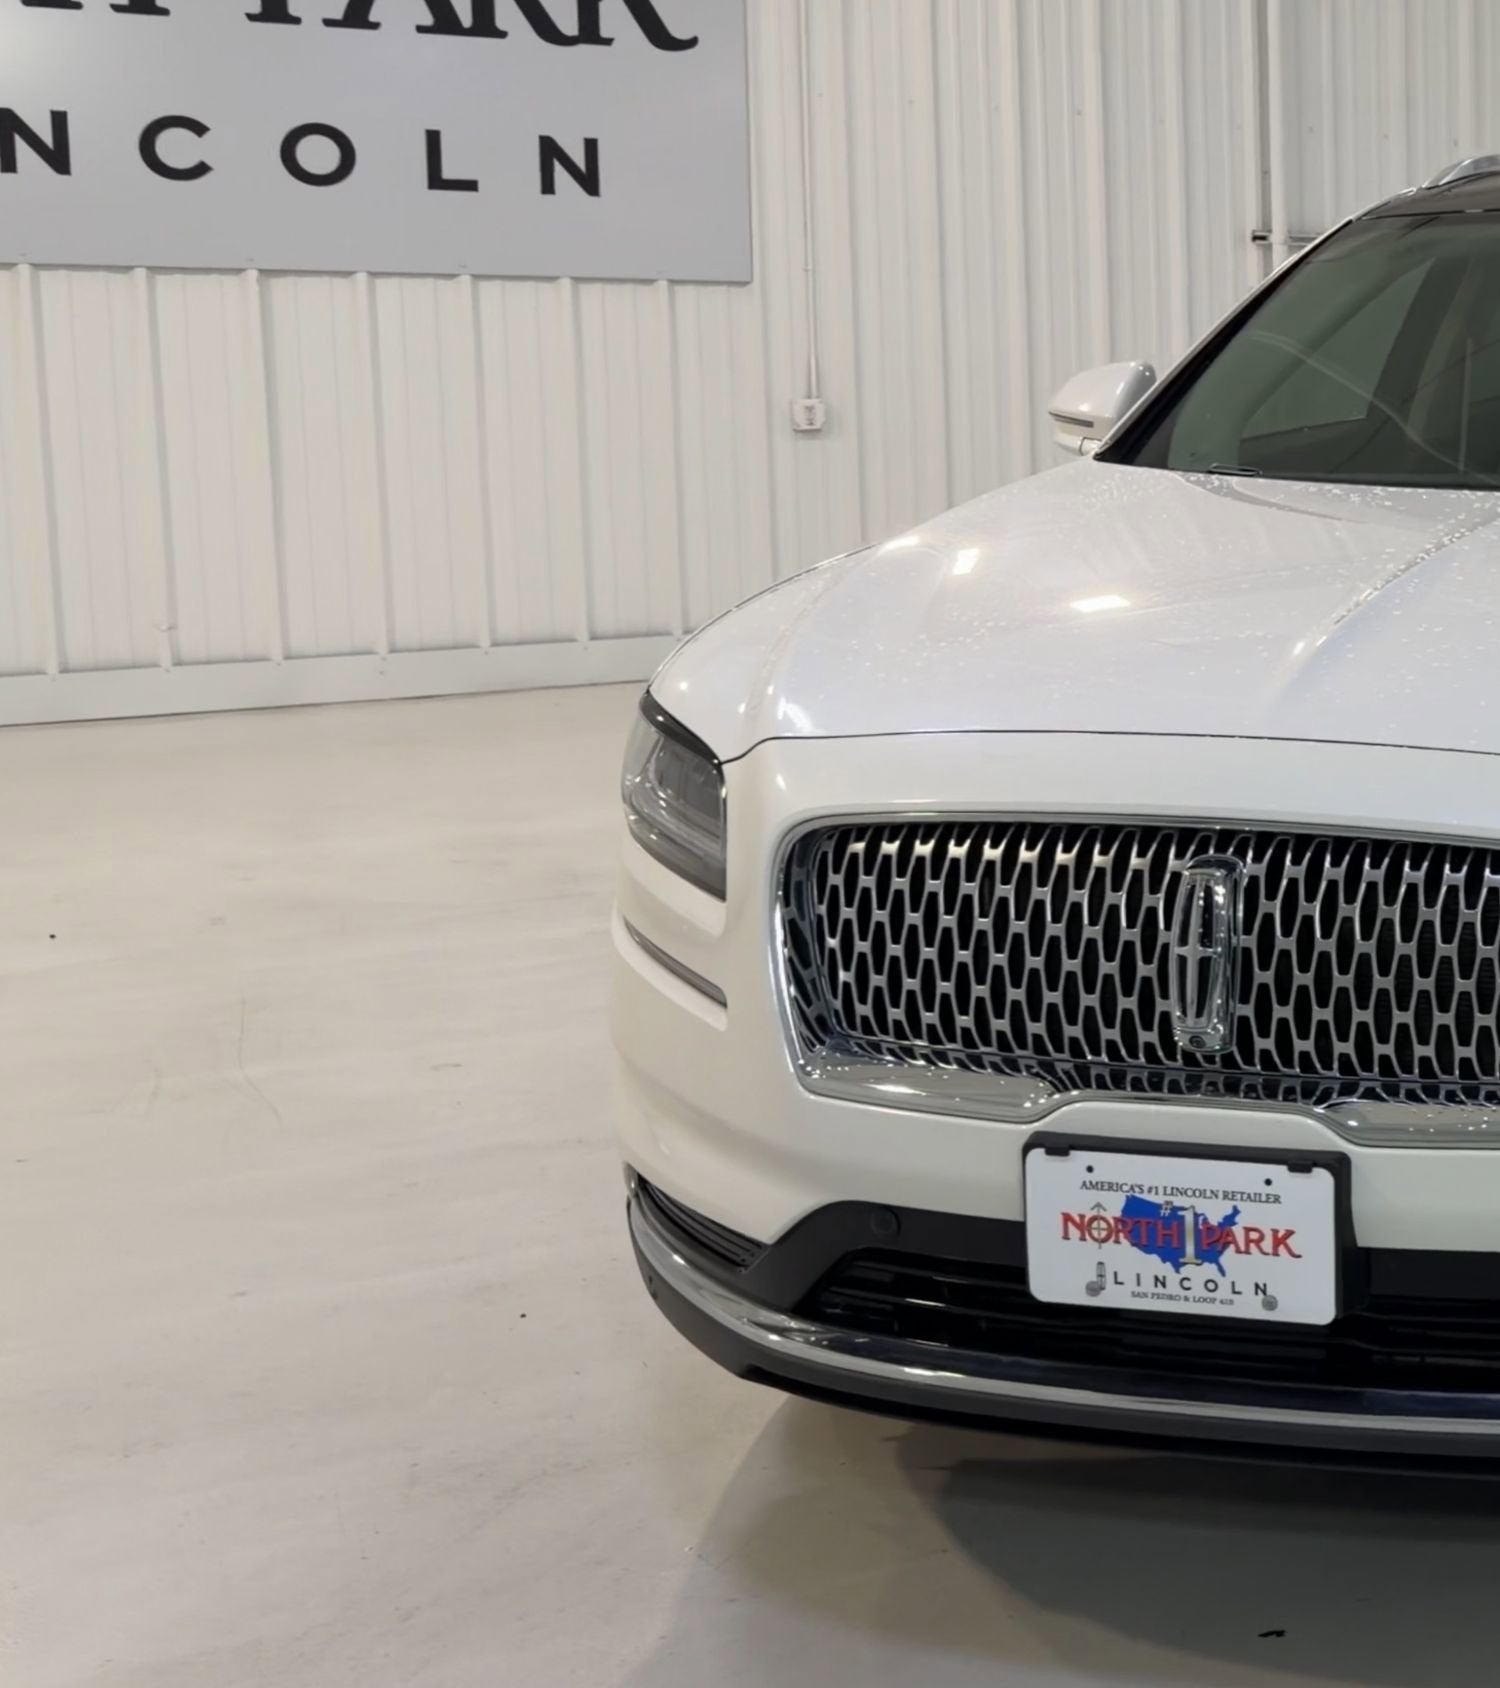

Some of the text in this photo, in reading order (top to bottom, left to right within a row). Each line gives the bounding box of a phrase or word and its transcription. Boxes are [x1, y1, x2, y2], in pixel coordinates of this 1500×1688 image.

[1080, 1180, 1282, 1204] AMERICA'S #1 LINCOLN RETAILER
[1060, 1211, 1303, 1259] NORTH PARK
[1113, 1270, 1268, 1297] LINCOLN
[1193, 1295, 1217, 1304] LOOP
